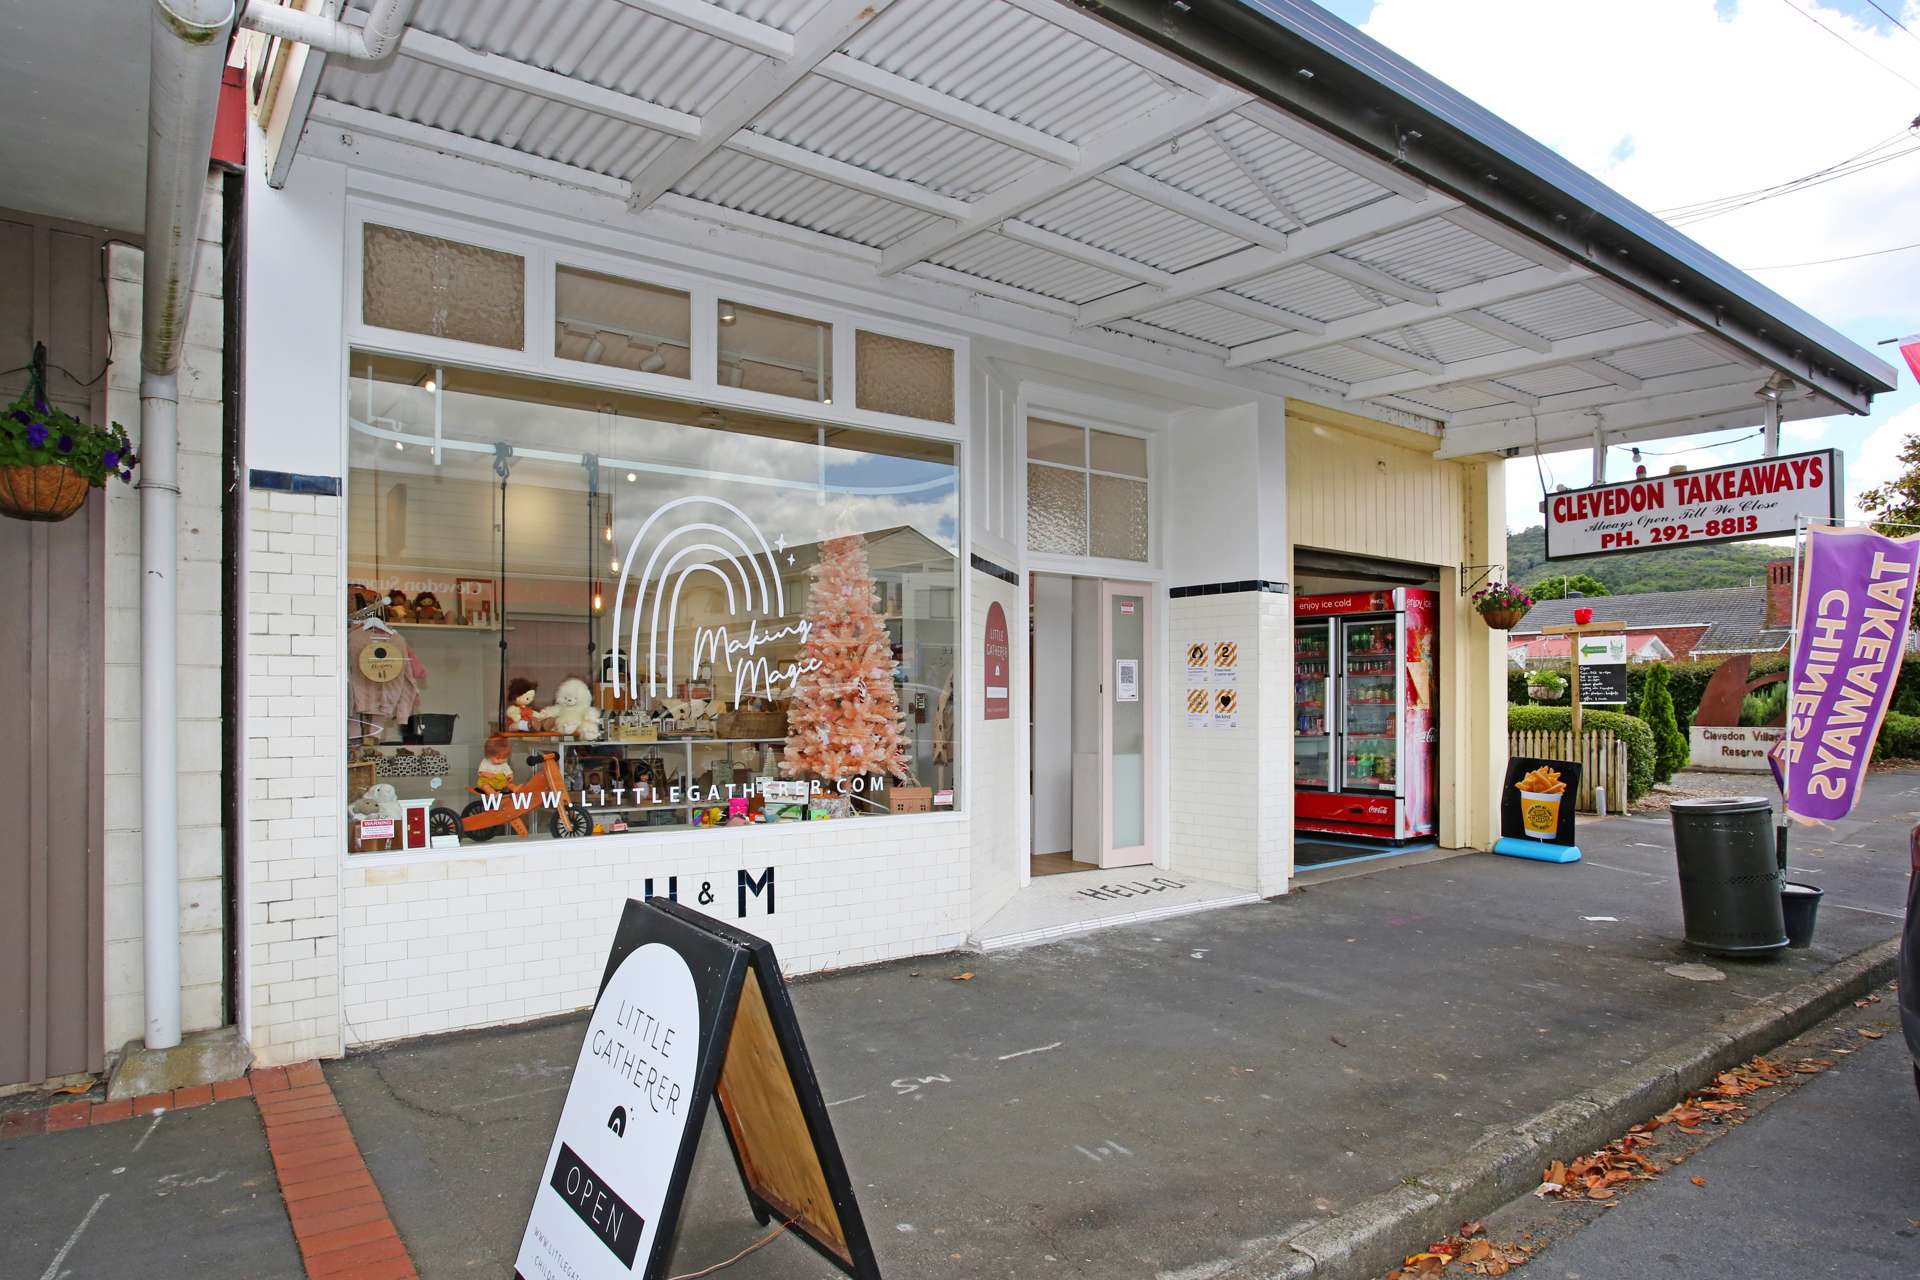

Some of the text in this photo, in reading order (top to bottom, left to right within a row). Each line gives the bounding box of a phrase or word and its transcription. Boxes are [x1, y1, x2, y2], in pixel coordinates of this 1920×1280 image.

[1553, 456, 1824, 524] CLEVEDON TAKEAWAYS
[1584, 499, 1779, 534] Always Open, Till We Close
[1600, 515, 1758, 549] PH. 292-8813
[1299, 598, 1352, 611] enjoy ice cold
[693, 619, 812, 681] Making
[735, 657, 823, 711] Magic
[1703, 730, 1780, 742] Clevedon Villag
[1721, 746, 1764, 757] Reserve
[481, 776, 884, 811] WWW.LITTLEGATHERER.COM
[698, 881, 714, 905] &
[738, 867, 775, 918] M
[616, 999, 675, 1058] LITTLE
[592, 1029, 681, 1116] GATHERER
[566, 1166, 624, 1243] OPEN
